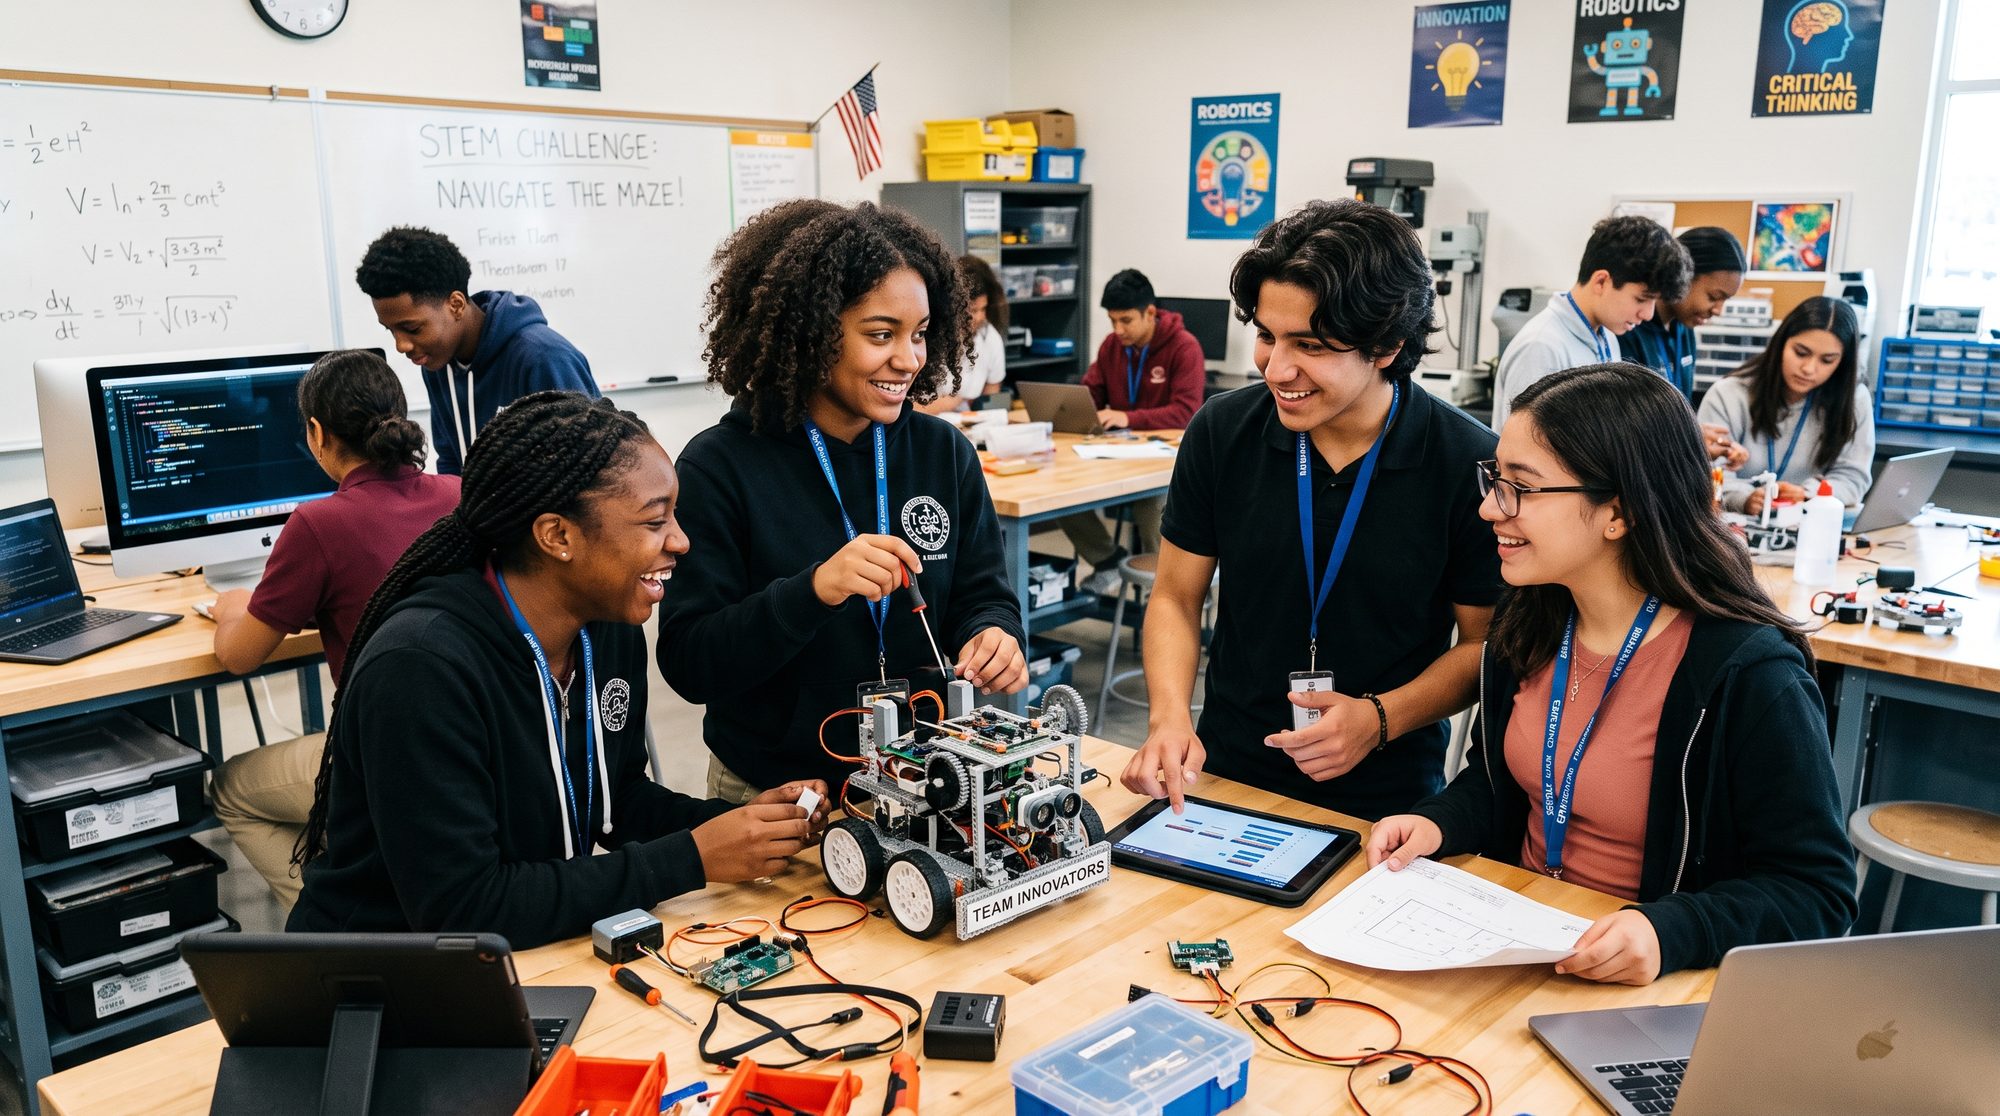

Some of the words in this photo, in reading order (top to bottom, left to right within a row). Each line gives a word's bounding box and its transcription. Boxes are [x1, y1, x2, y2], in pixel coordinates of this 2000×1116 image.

[283, 11, 290, 23] 7
[299, 17, 307, 30] 6
[1416, 5, 1507, 29] INNOVATION
[1769, 71, 1858, 94] CRITICAL
[1197, 101, 1273, 120] ROBOTICS
[1765, 91, 1858, 113] THINKING
[420, 123, 501, 159] STEM
[516, 127, 658, 160] CHALLENGE:
[437, 179, 556, 209] NAVIGATE
[566, 180, 607, 208] THE
[617, 175, 685, 208] MAZE!
[972, 896, 1013, 923] TEAM
[1017, 860, 1106, 906] INNOVATORS
